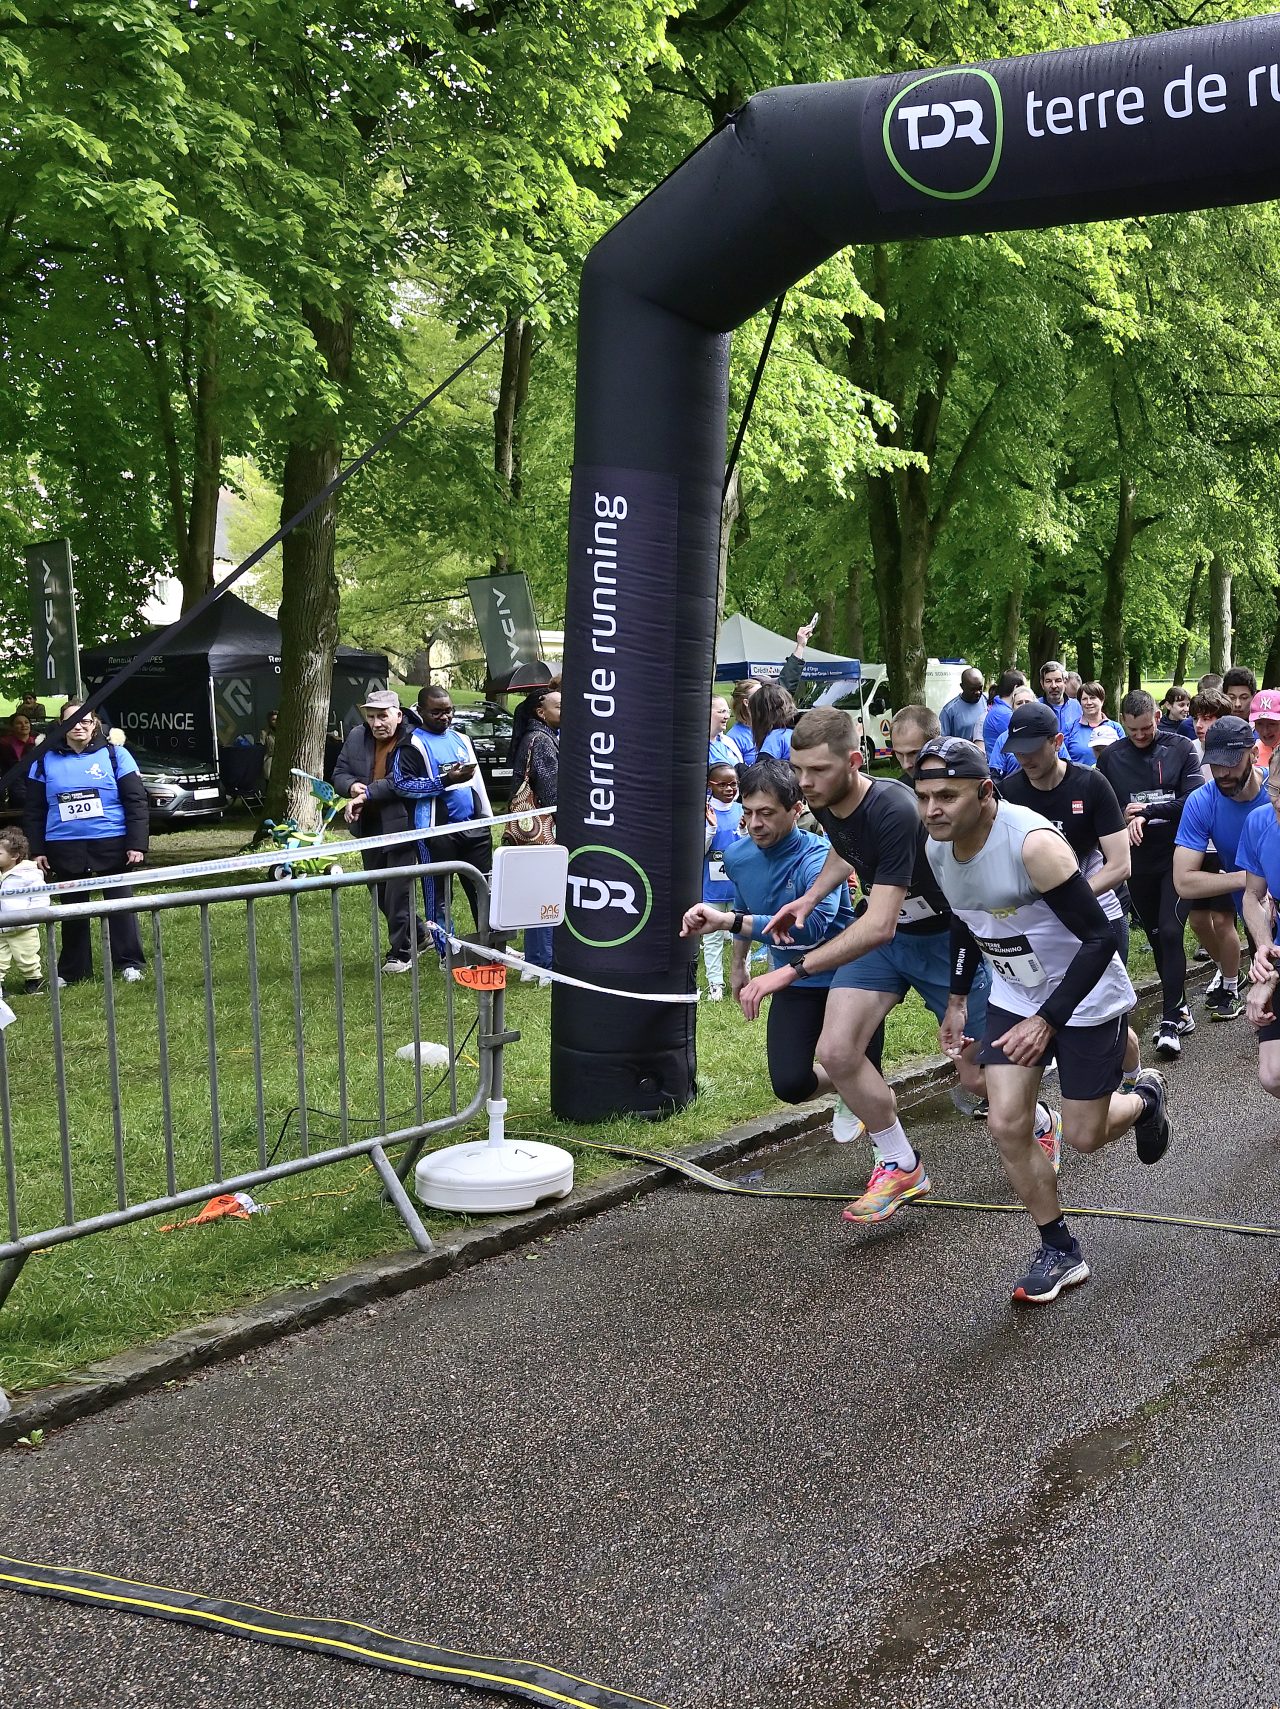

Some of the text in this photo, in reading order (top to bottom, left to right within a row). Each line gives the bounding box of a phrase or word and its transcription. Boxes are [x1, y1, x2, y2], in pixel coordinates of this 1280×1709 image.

[899, 99, 991, 150] TDR
[1025, 87, 1144, 137] terre
[1164, 64, 1227, 119] de
[583, 491, 628, 827] terre de running
[120, 712, 195, 731] LOSANGE
[137, 736, 196, 748] UTOS
[67, 802, 91, 814] 320
[567, 874, 640, 914] TDR
[955, 948, 966, 976] KIPRUN
[992, 959, 1016, 977] 61
